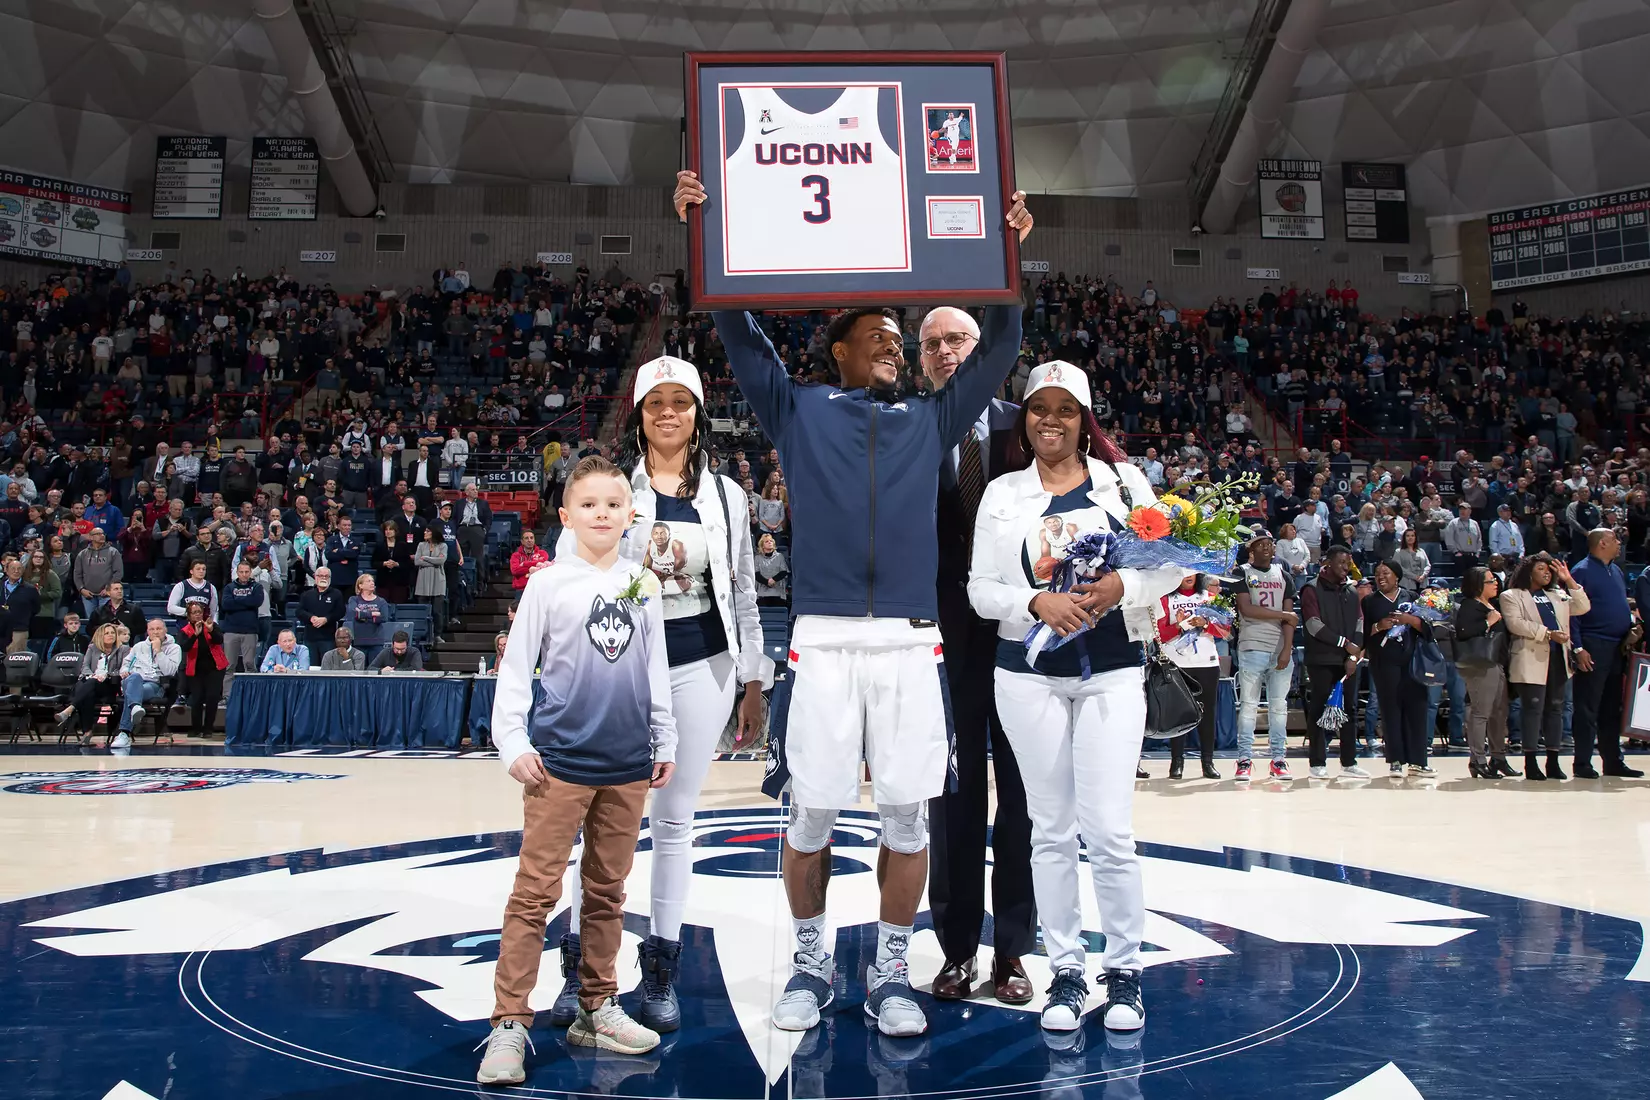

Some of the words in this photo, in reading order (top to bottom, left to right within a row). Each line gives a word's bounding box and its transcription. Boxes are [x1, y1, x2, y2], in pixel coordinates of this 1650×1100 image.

[755, 142, 873, 165] UCONN
[27, 188, 63, 201] FINAL
[69, 195, 102, 207] FOUR
[801, 174, 831, 224] 3
[1491, 213, 1515, 224] BIG
[1522, 204, 1560, 219] EAST
[1492, 219, 1543, 233] REGULAR
[1548, 211, 1594, 224] SEASON
[140, 250, 162, 259] 206
[315, 252, 335, 260] 207
[551, 254, 571, 262] 208
[1030, 262, 1048, 270] 210
[1265, 269, 1279, 278] 211
[1413, 274, 1429, 282] 212
[1497, 272, 1567, 288] CONNECTICUT
[510, 470, 538, 482] 108
[1259, 591, 1275, 607] 21
